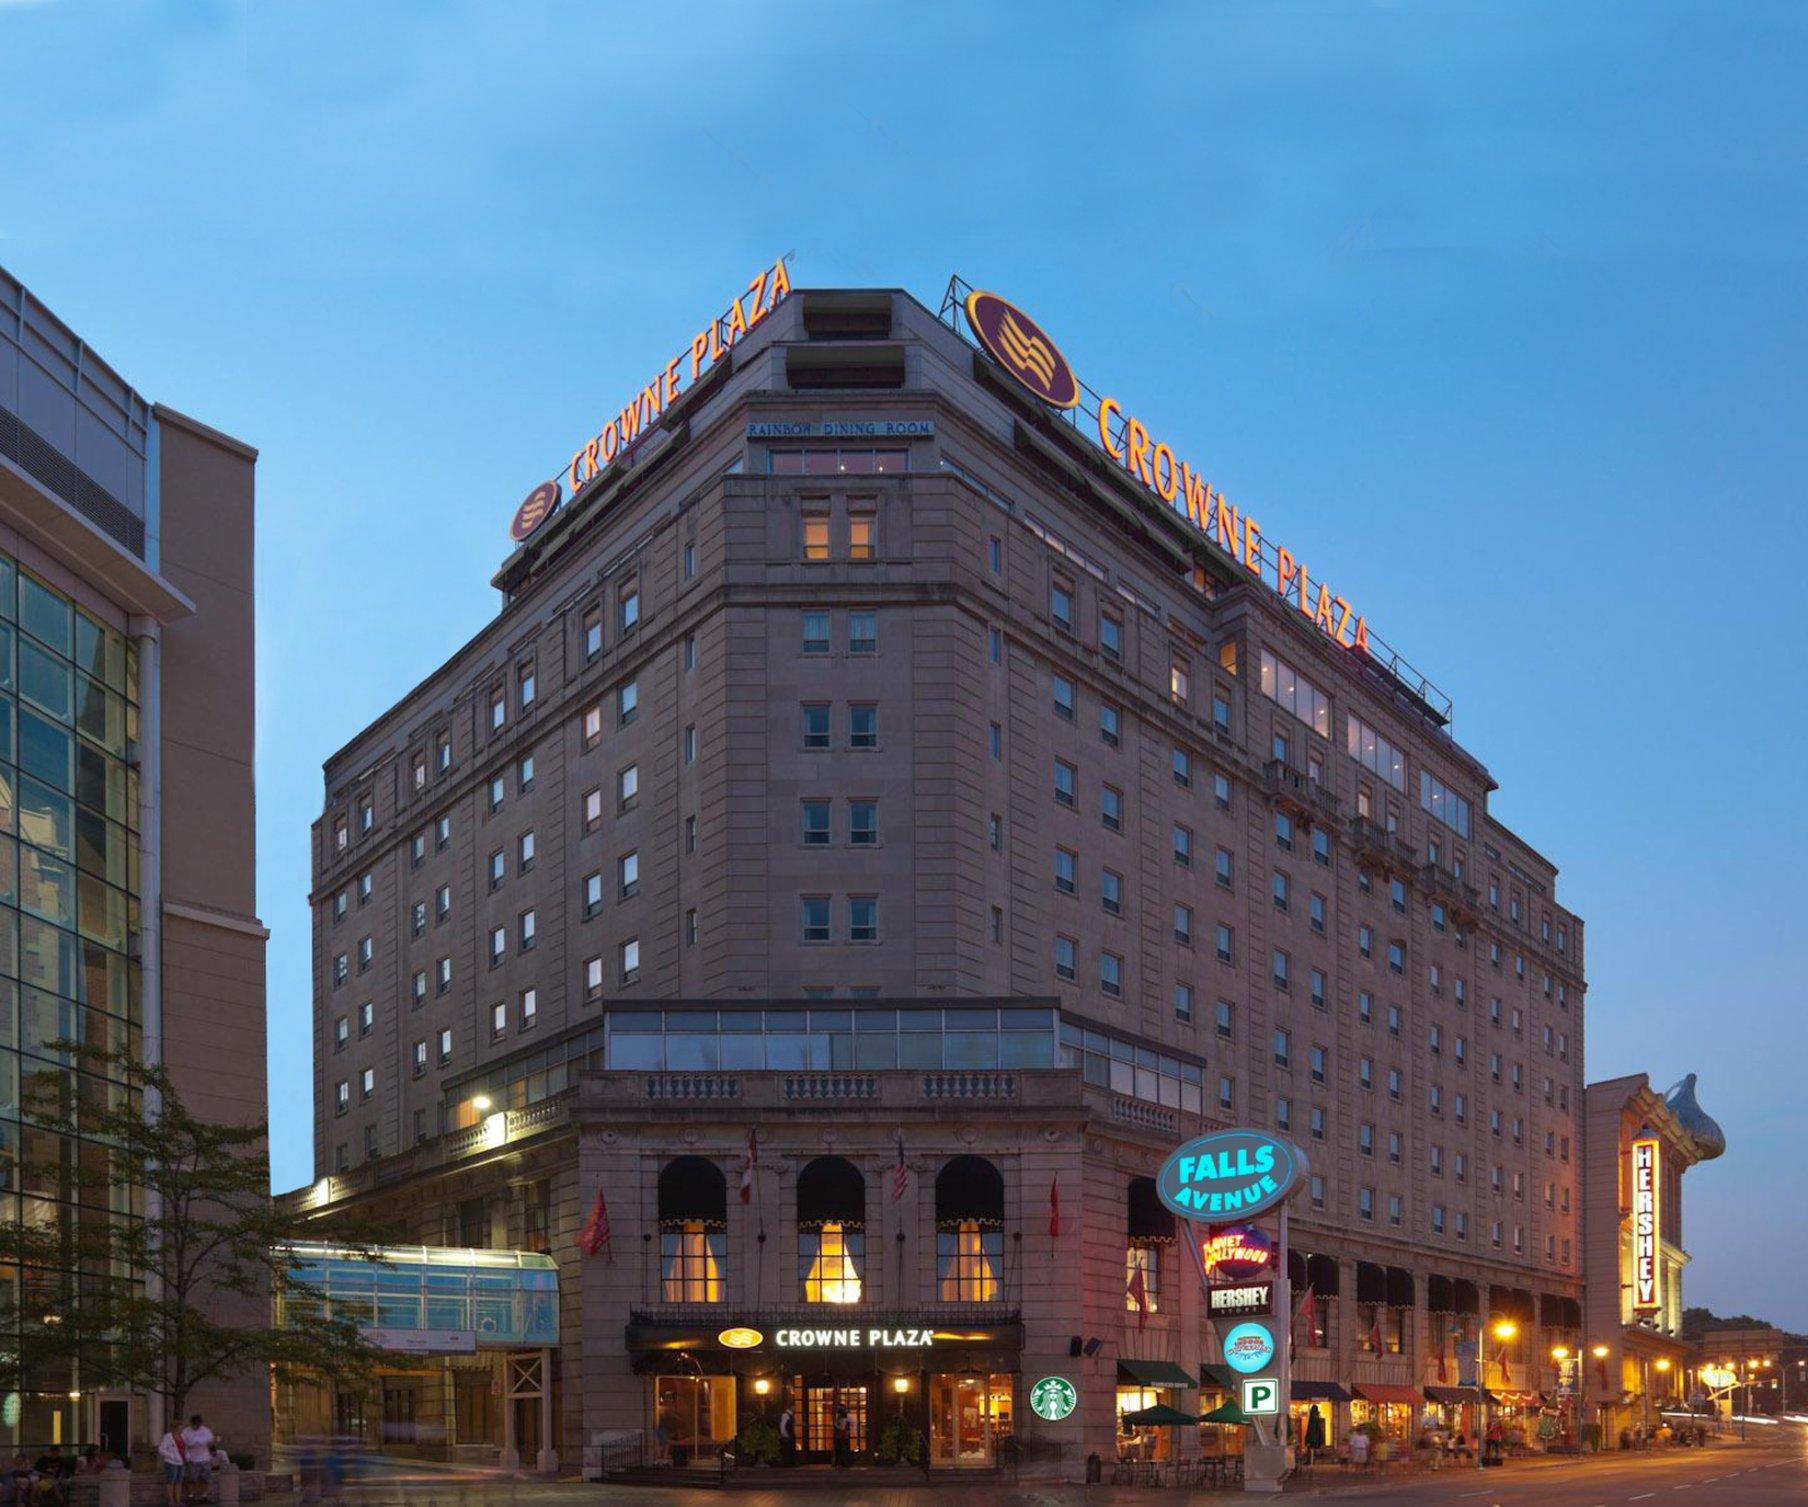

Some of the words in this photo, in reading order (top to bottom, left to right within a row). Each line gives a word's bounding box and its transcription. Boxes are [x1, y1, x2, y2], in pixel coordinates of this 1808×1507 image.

[569, 358, 681, 493] CROWNE
[692, 257, 793, 381] PLAZA
[750, 423, 812, 436] RAINBOW
[824, 424, 876, 435] DINING
[886, 422, 930, 434] ROOM
[1099, 398, 1262, 575] CROWNE
[1277, 546, 1370, 652] PLAZA
[1179, 1145, 1276, 1184] FALLS
[1174, 1174, 1278, 1211] AVENUE
[1638, 1147, 1654, 1302] HERSHEY
[1211, 1286, 1269, 1308] HERSHEY
[775, 1329, 861, 1347] CROWNE
[869, 1329, 933, 1347] PLAZA
[1251, 1386, 1271, 1409] P
